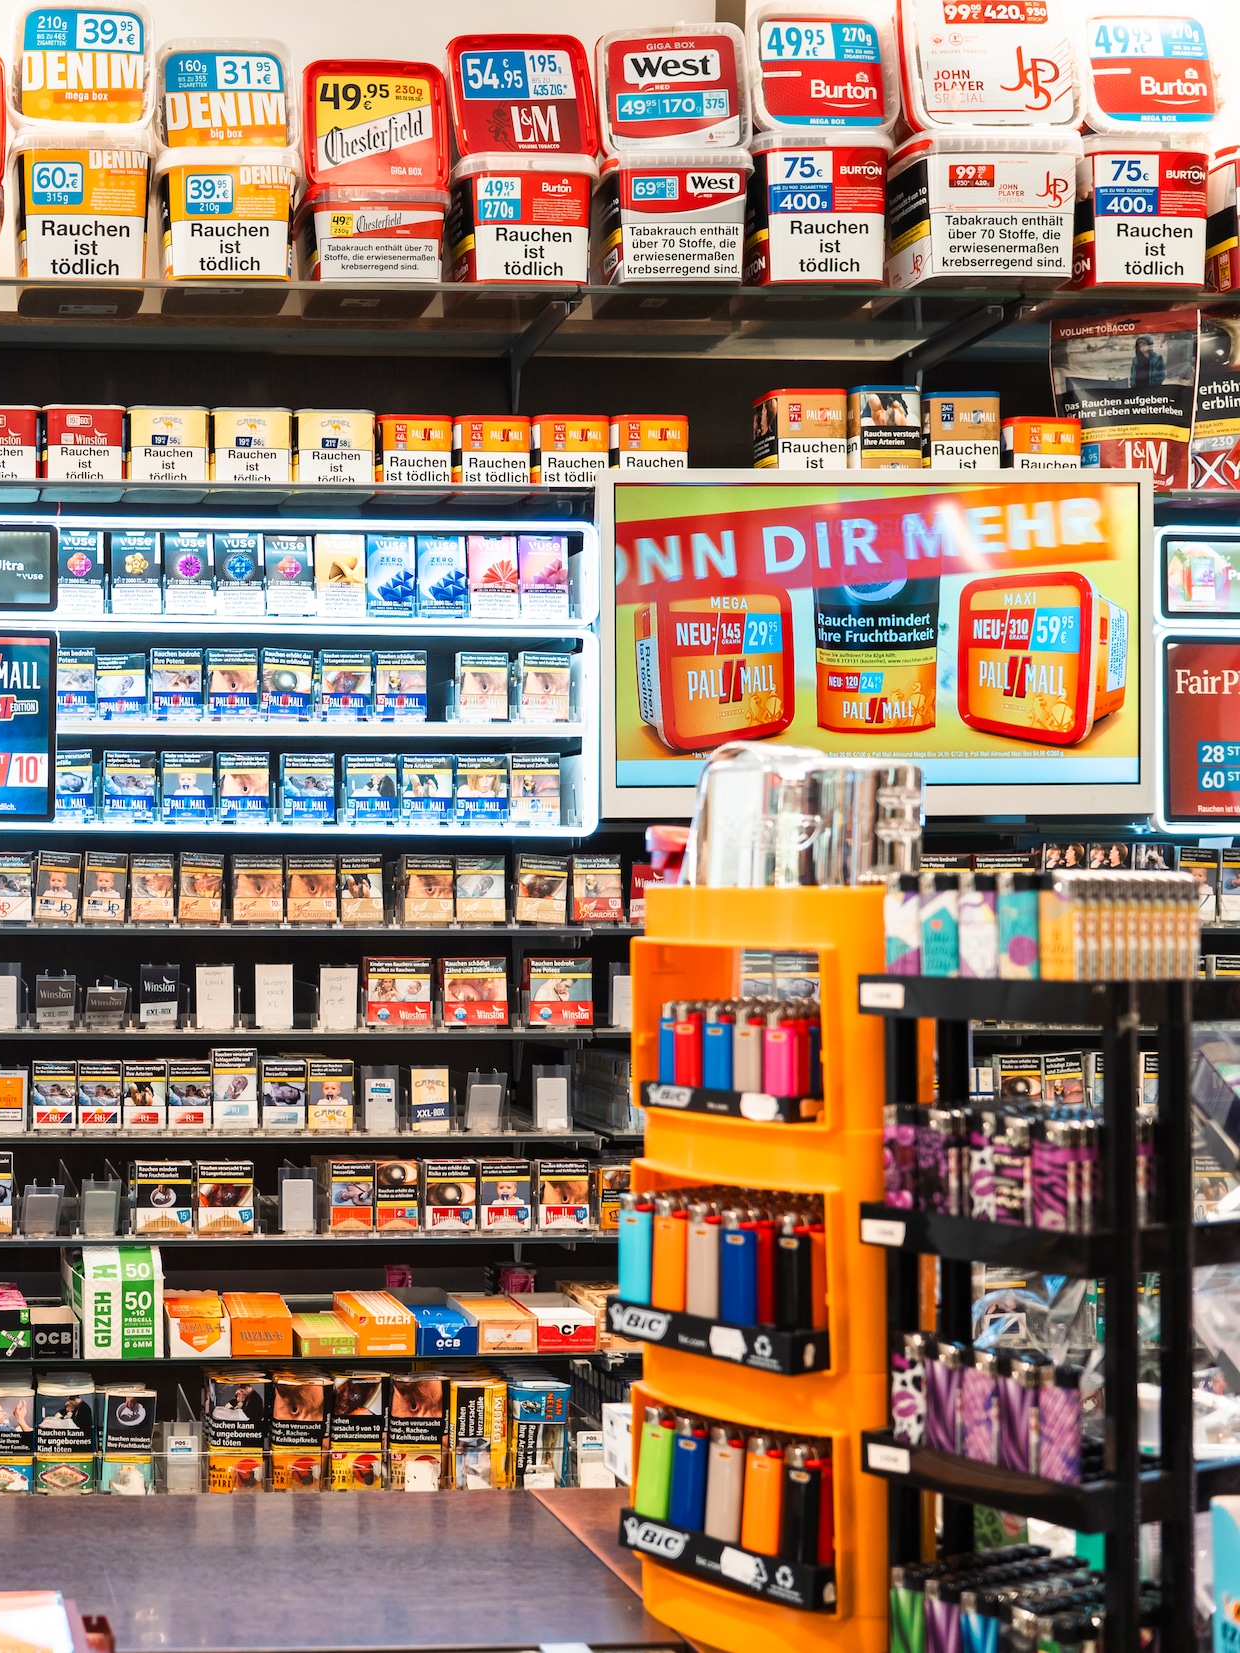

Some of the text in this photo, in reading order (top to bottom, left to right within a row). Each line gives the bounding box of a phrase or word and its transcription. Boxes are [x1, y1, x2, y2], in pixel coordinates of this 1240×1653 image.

[22, 51, 144, 90] DENIM
[632, 56, 710, 78] West
[934, 70, 970, 80] JOHN
[811, 80, 877, 100] Burton
[934, 81, 984, 91] PLAYER
[1140, 76, 1207, 97] Burton
[65, 91, 108, 102] mega box
[166, 92, 285, 130] DENIM
[511, 105, 560, 142] L&M
[210, 128, 242, 140] big box
[325, 110, 424, 166] Chesterfield
[390, 166, 422, 176] GIGA BOX
[840, 166, 882, 176] BURTON
[542, 182, 572, 192] Burton
[690, 176, 734, 189] West
[1060, 323, 1135, 338] VOLUME TOBACCO
[763, 518, 881, 574] DIR
[904, 497, 1110, 561] MEHR
[709, 596, 749, 610] MEGA
[1004, 593, 1037, 605] MAXI
[818, 611, 931, 626] Rauchen mindert
[676, 622, 740, 646] NEU: 145
[818, 627, 934, 644] Ihre Fruchtbarkeit
[973, 617, 1028, 640] NEU: 310
[11, 702, 36, 711] EDITION
[1202, 745, 1224, 763] 28
[16, 756, 38, 782] 10
[1202, 772, 1224, 788] 60
[143, 981, 175, 993] Winston
[562, 1009, 589, 1019] Winston
[416, 1108, 445, 1118] XXL-BOX
[124, 1292, 152, 1309] 50
[94, 1292, 111, 1348] GIZEH
[375, 1315, 411, 1326] GIZEH
[35, 1332, 71, 1345] OCB
[493, 1396, 503, 1444] DRUM
[48, 1438, 91, 1446] ungeborenes
